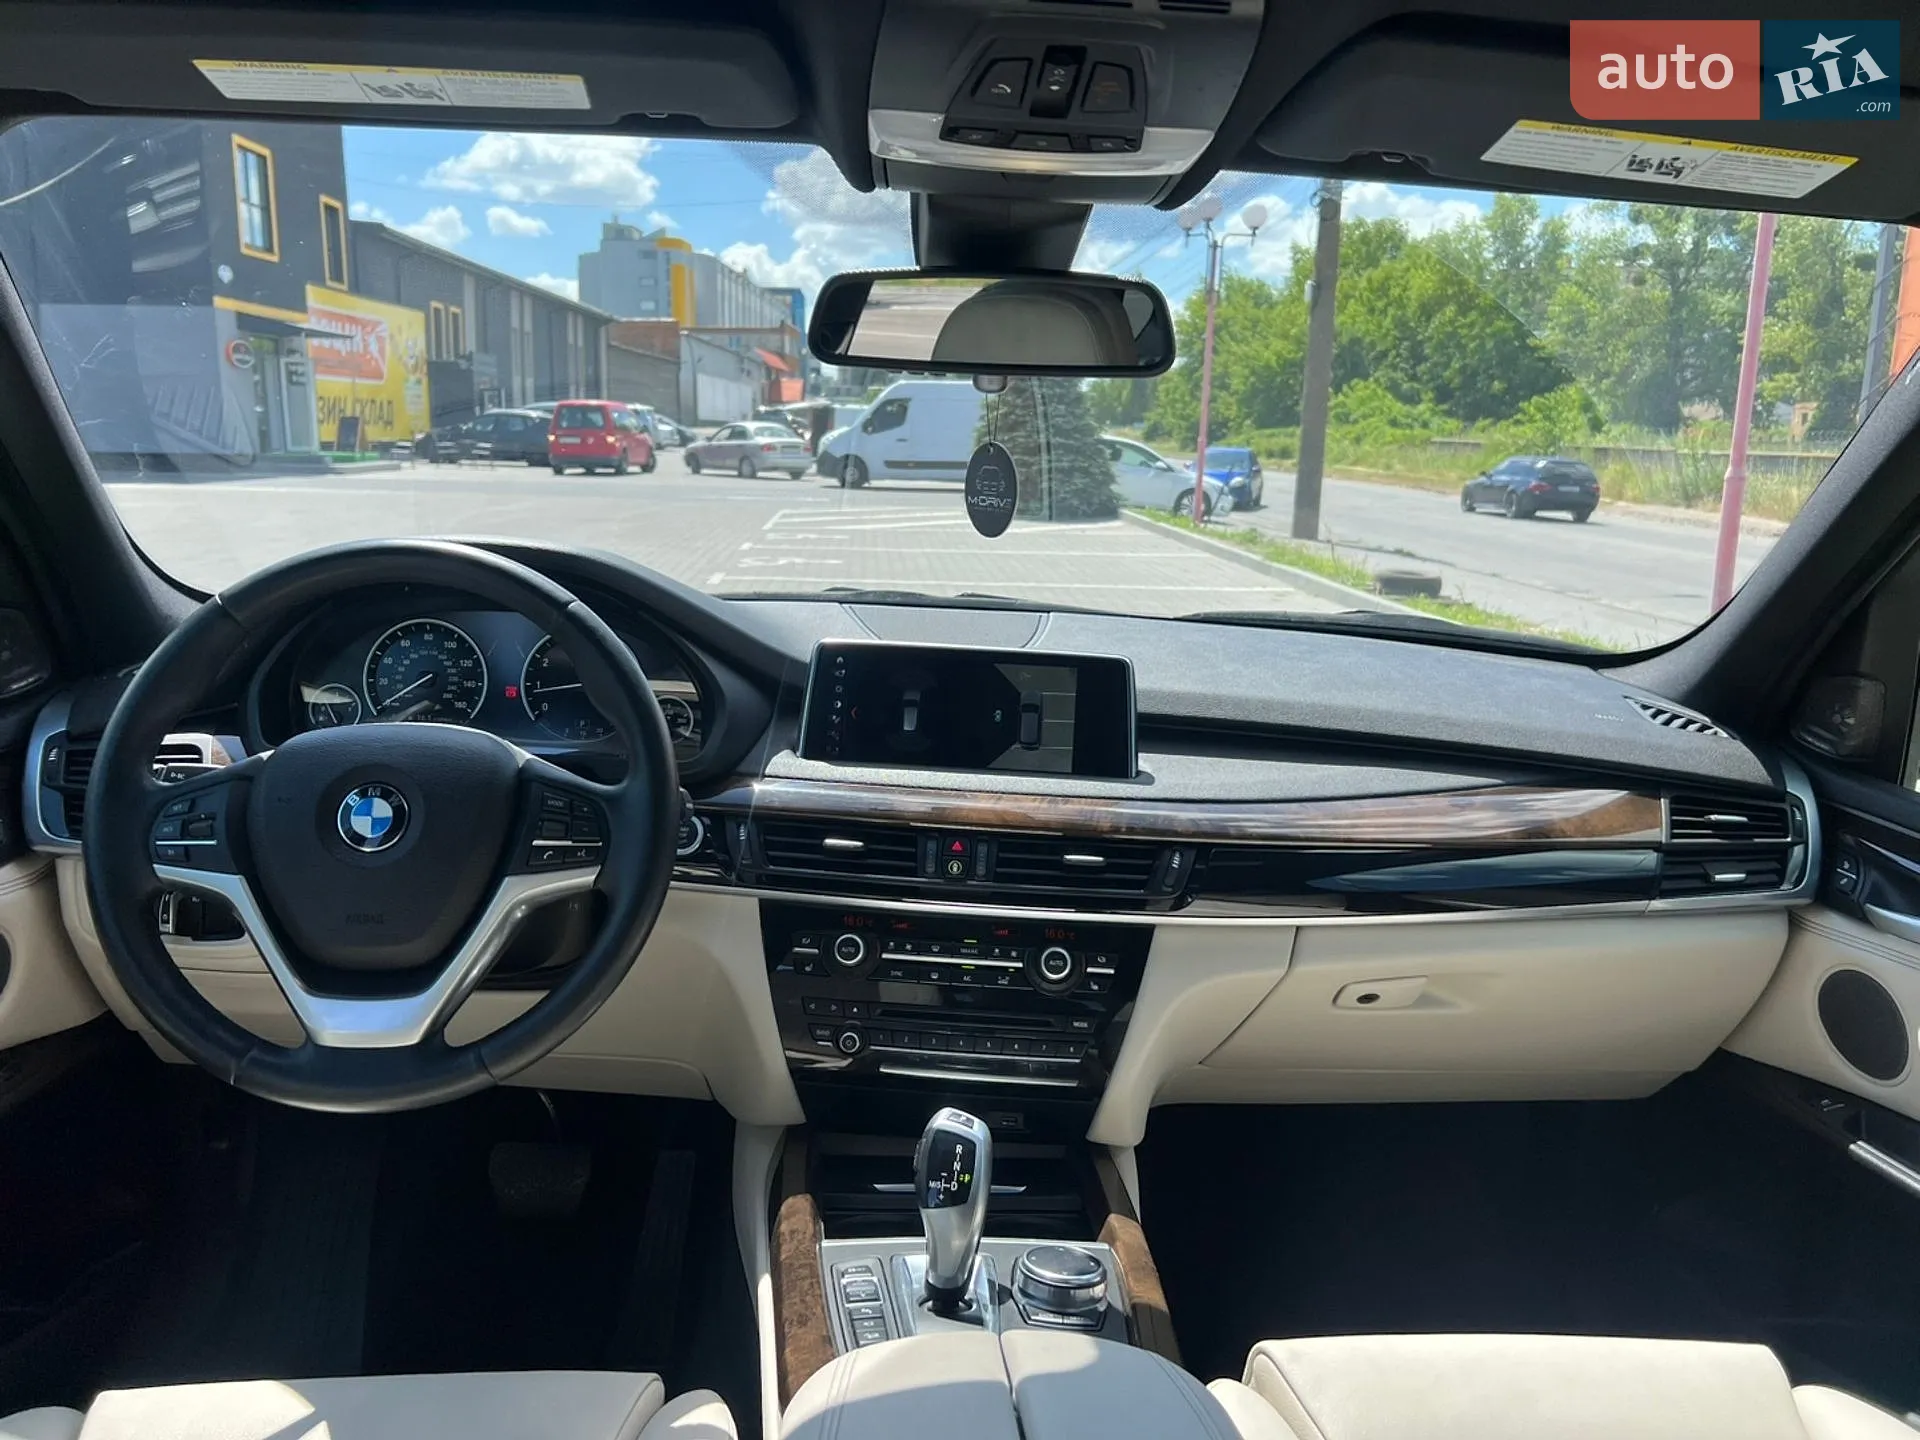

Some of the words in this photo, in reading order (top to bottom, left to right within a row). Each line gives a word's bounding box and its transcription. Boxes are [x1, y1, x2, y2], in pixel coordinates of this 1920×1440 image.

[1551, 124, 1615, 138] WARNING
[1729, 144, 1839, 163] AVERTISSEMENT
[401, 640, 411, 648] 60
[542, 658, 549, 667] 2
[542, 703, 548, 711] 0
[347, 787, 402, 807] BMW
[956, 1144, 963, 1153] R
[953, 1161, 961, 1171] N
[950, 1181, 958, 1191] D
